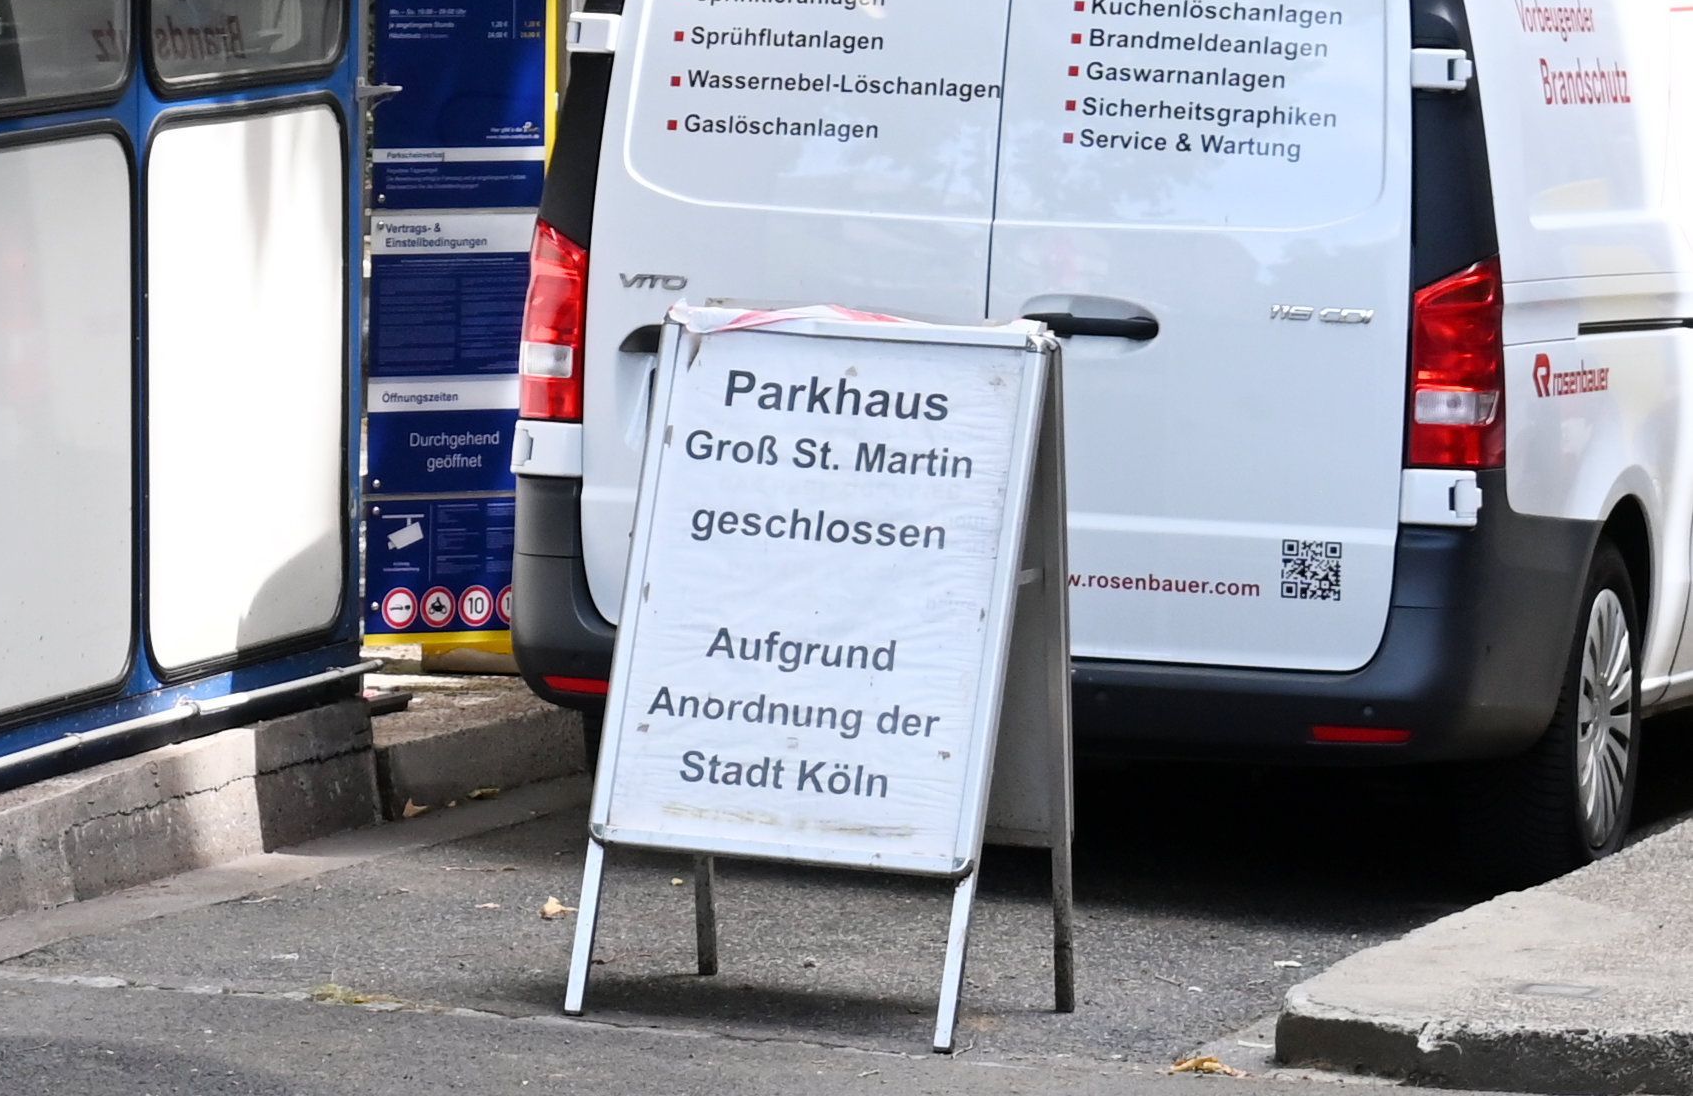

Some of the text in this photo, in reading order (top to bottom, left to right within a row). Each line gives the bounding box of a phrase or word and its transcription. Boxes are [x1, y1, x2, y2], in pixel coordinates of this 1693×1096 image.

[691, 26, 884, 51] Sprühflutanlagen
[1089, 29, 1328, 61] Brandmeldeanlagen
[687, 69, 1001, 103] Wassernebel-Löschanlagen
[1086, 61, 1286, 92] Gaswarnanlagen
[1539, 57, 1631, 105] Brandschutz
[684, 114, 879, 142] Gaslöschanlagen
[1082, 96, 1337, 128] Sicherheitsgraphiken
[1079, 129, 1302, 163] Service & Wartung
[385, 222, 442, 235] Vertrags- &
[385, 237, 488, 249] Einstellbedingungen
[1553, 359, 1610, 397] rosenbauer
[382, 390, 459, 405] Öffnungszeiten
[724, 369, 949, 421] Parkhaus
[409, 430, 500, 450] Durchgehend
[685, 429, 973, 479] Groß St. Martin
[426, 453, 483, 472] geöffnet
[691, 508, 946, 550] geschlossen
[468, 597, 484, 615] 10
[706, 627, 897, 673] Aufgrund
[647, 686, 941, 739] Anordnung der
[679, 750, 889, 799] Stadt Köln
